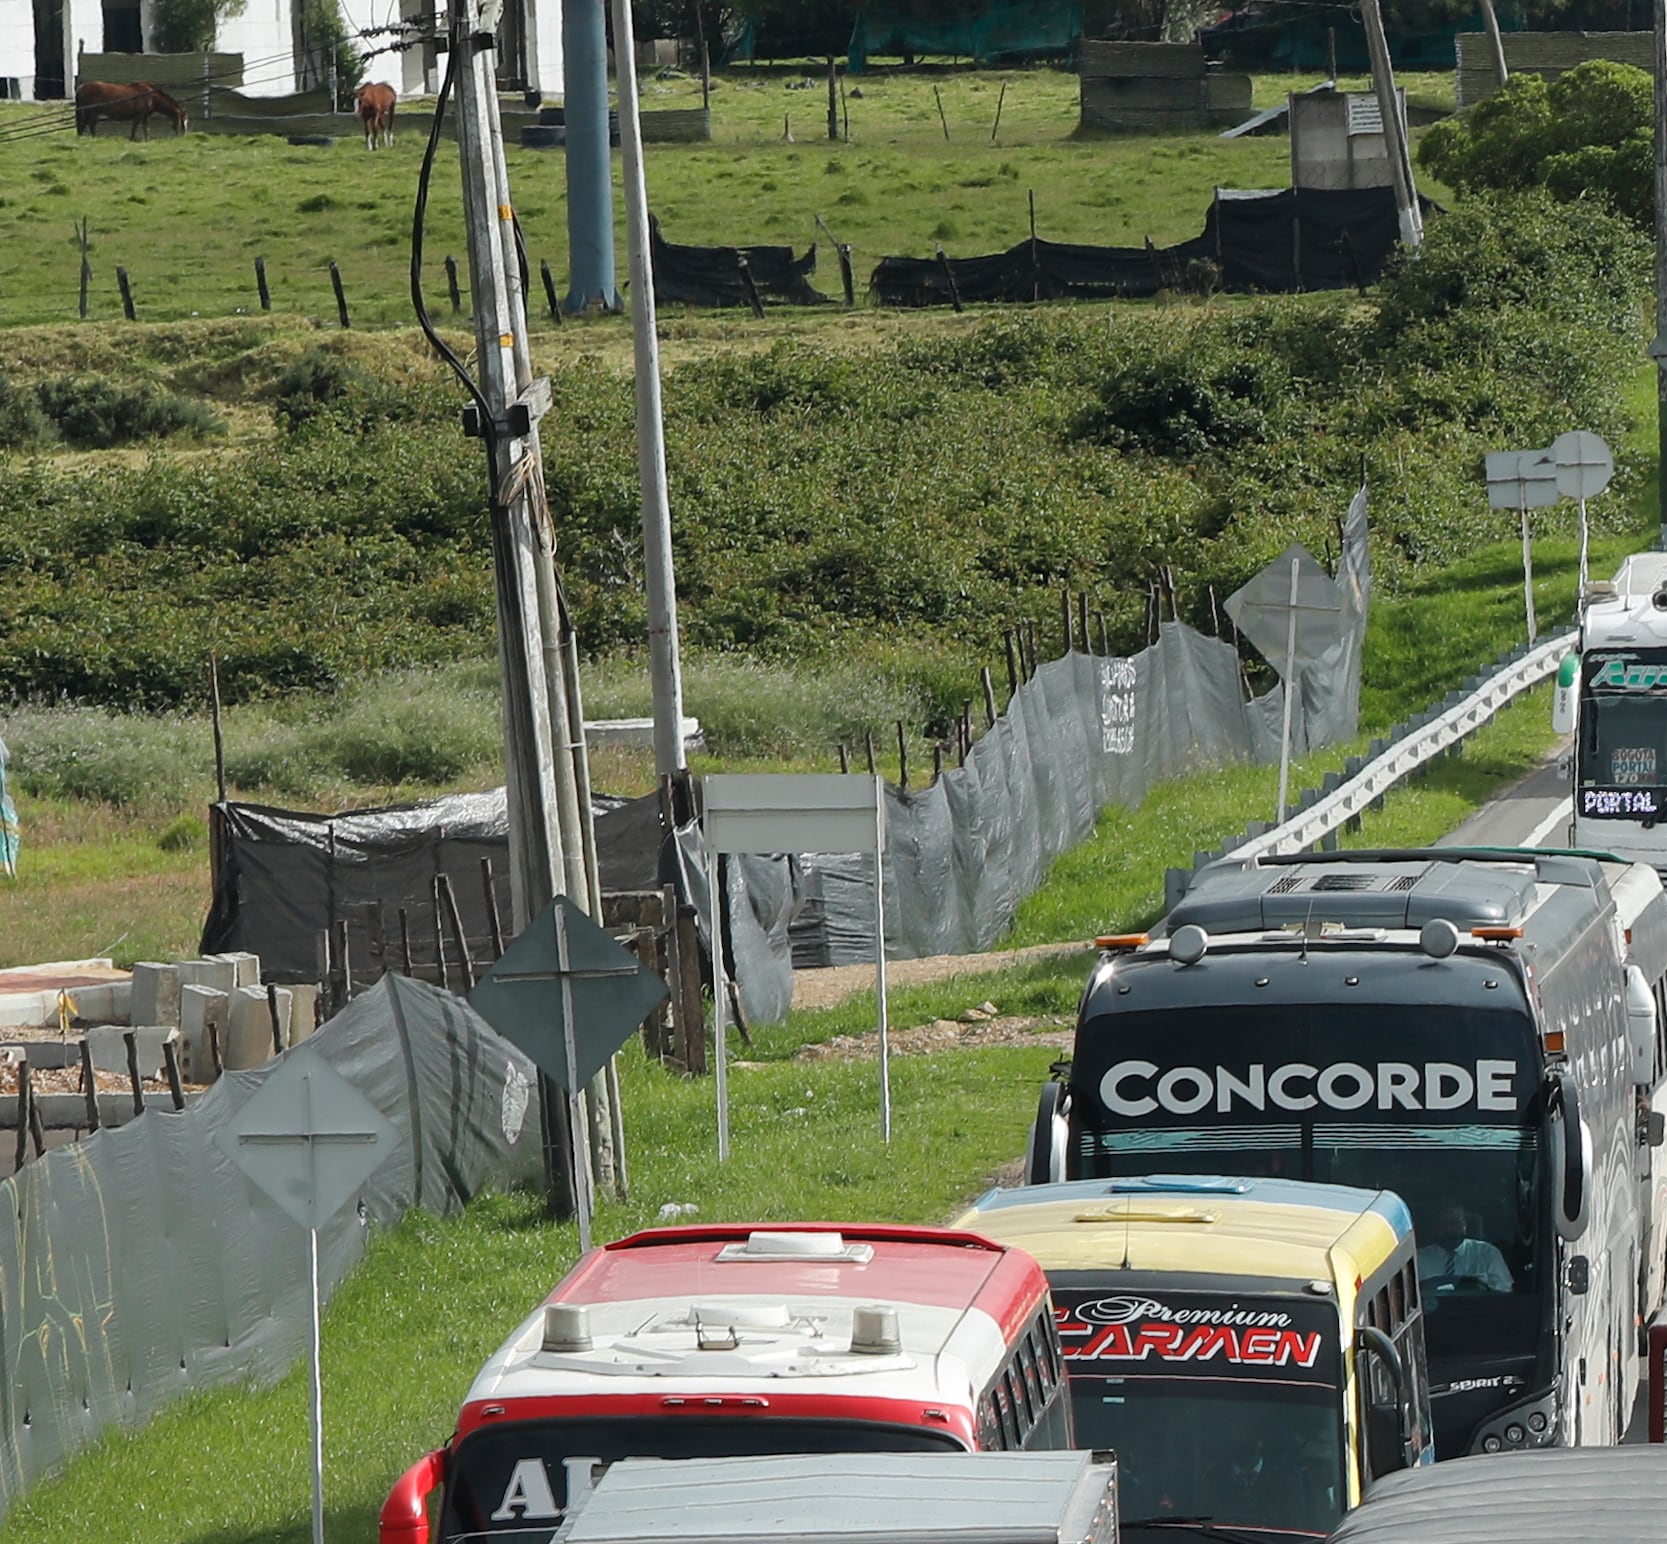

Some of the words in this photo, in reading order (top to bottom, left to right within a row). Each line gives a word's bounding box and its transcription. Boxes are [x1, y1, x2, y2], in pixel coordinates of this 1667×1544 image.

[1584, 790, 1657, 814] PORTAL
[1099, 1059, 1518, 1118] CONCORDE
[1075, 1296, 1293, 1338] Premium
[1057, 1323, 1321, 1370] CARMEN
[1449, 1377, 1500, 1391] SPIRIT
